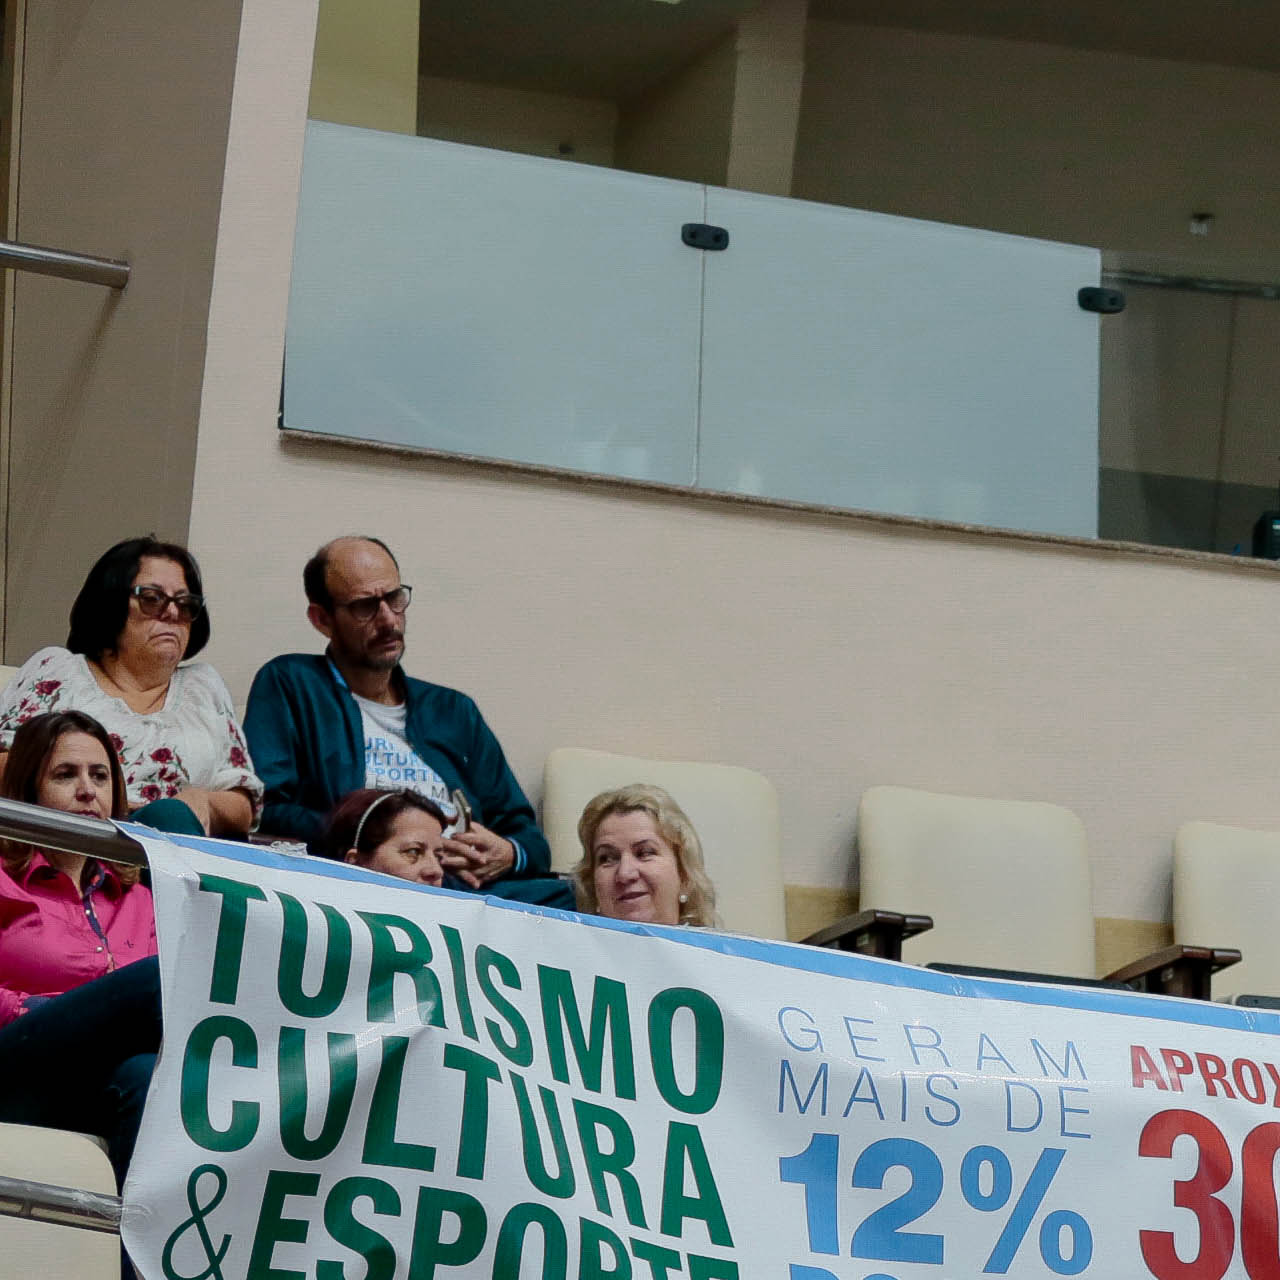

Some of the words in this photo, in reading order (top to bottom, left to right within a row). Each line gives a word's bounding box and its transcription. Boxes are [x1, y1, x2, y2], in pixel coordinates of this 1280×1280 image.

[200, 875, 724, 1114] TURISMO
[777, 1007, 1087, 1080] GERAM
[181, 1015, 735, 1248] CULTURA
[778, 1060, 962, 1127] MAIS
[1007, 1081, 1092, 1139] DE
[779, 1132, 1094, 1276] 12%
